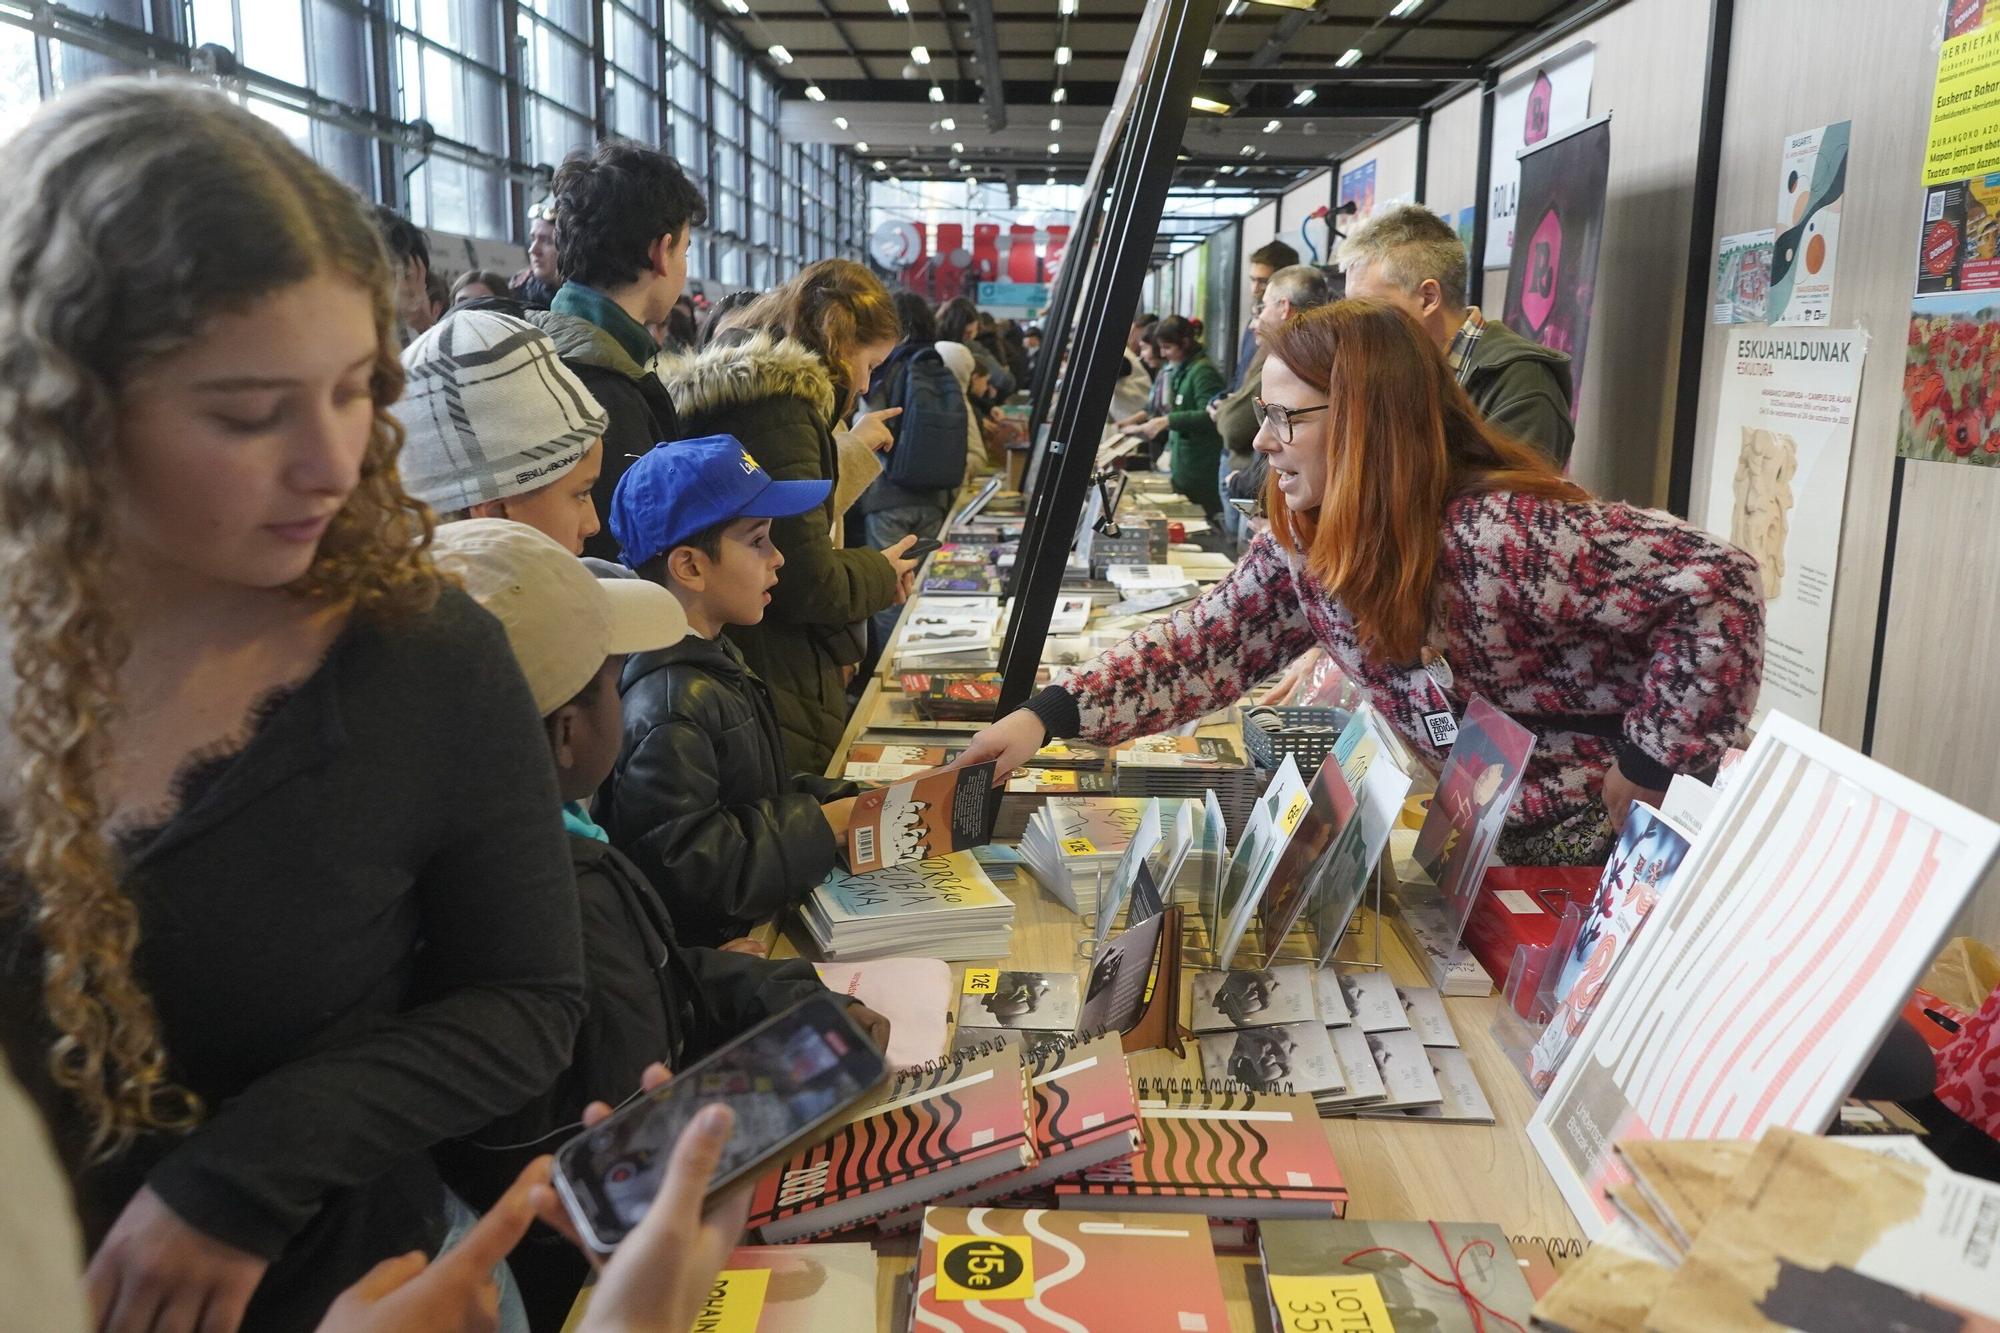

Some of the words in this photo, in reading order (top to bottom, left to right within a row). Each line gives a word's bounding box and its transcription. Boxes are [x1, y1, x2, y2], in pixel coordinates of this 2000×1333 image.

[1931, 129, 1979, 148] DURANGOKO
[1738, 339, 1851, 363] ESKUAHALDUNAK
[1429, 716, 1449, 727] GENO
[1435, 732, 1449, 742] EZ!
[1067, 839, 1089, 856] 12€
[970, 973, 991, 989] 12€
[777, 1160, 831, 1207] 2026
[967, 1244, 1005, 1287] 15€
